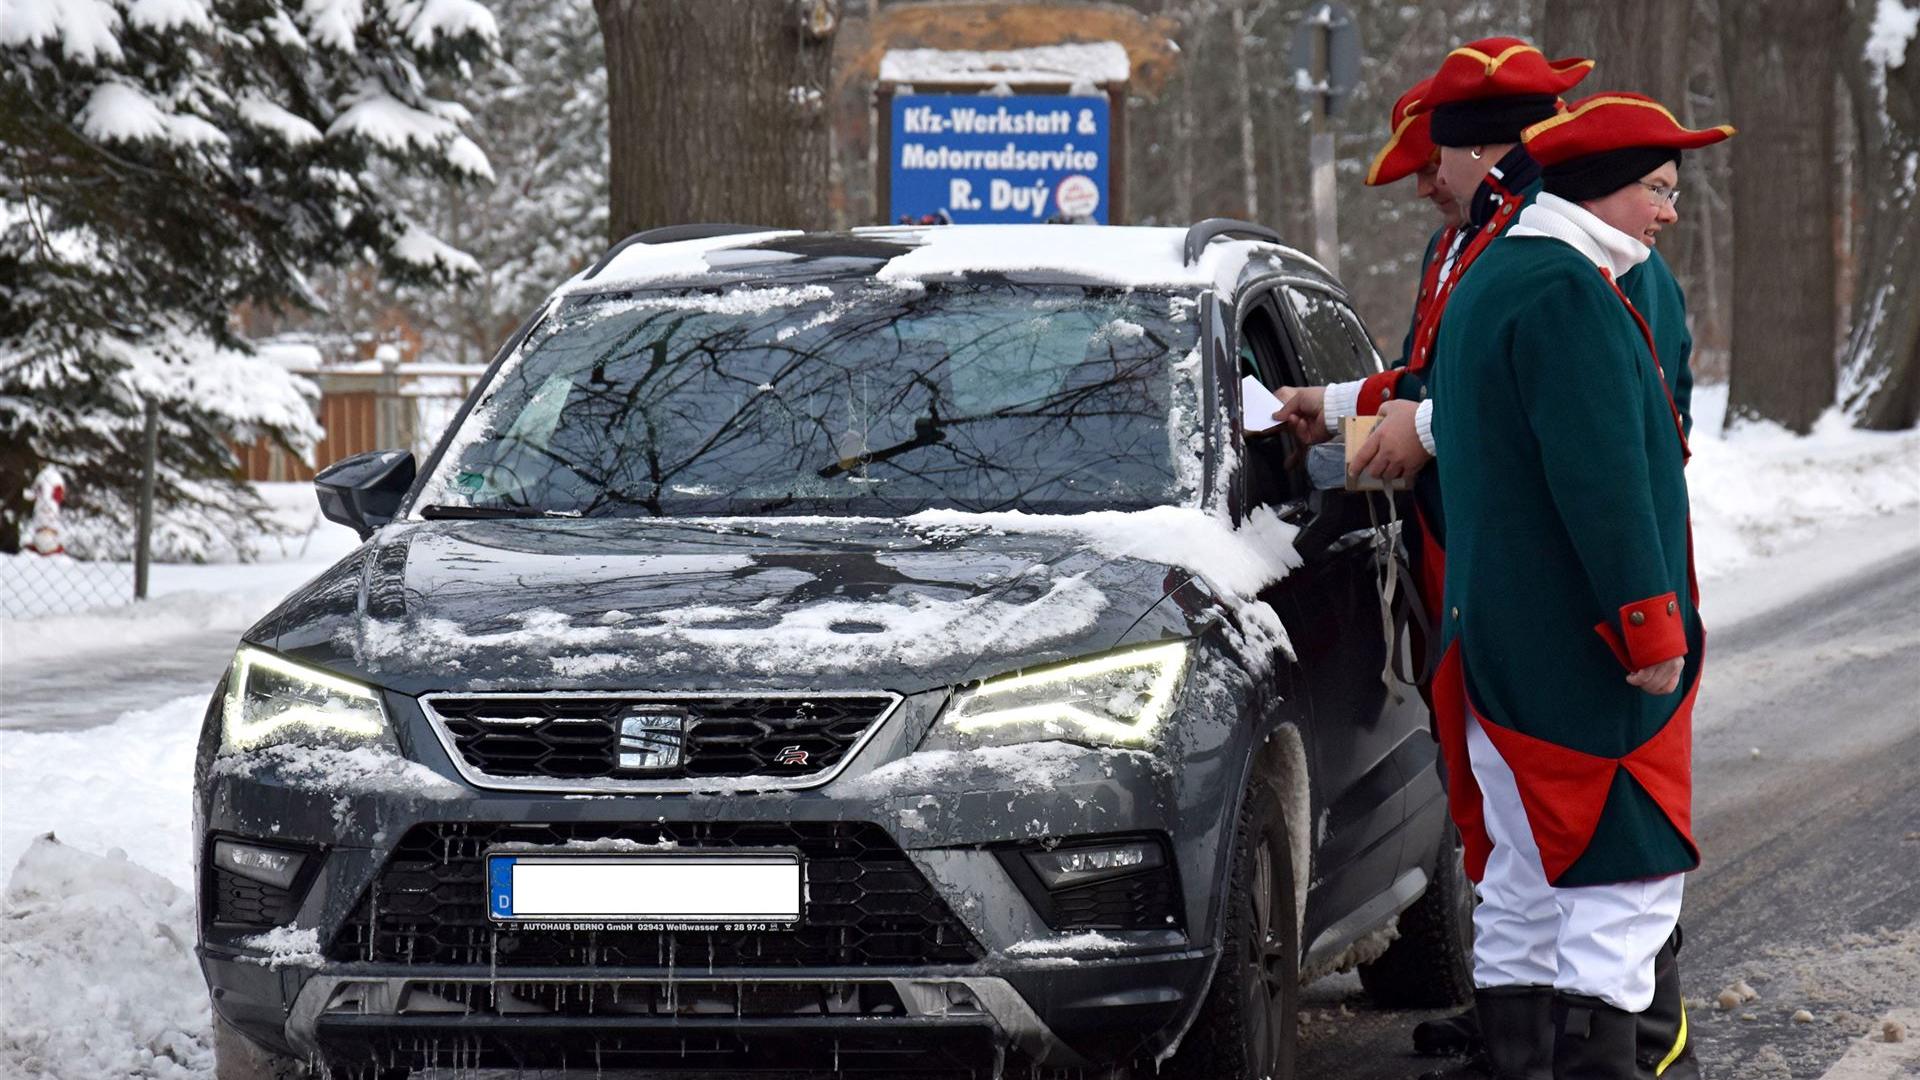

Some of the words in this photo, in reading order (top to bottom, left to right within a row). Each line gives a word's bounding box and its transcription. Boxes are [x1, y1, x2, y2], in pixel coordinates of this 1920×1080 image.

[904, 106, 1071, 134] Kfz-Werkstatt
[1076, 108, 1096, 135] &
[901, 142, 1098, 170] Motorradservice
[949, 178, 982, 211] R.
[499, 895, 510, 909] D
[523, 923, 571, 931] AUTOHAUS
[573, 923, 604, 931] DERNO
[606, 923, 633, 931] GmbH
[637, 923, 664, 931] 02943
[733, 923, 745, 931] 28
